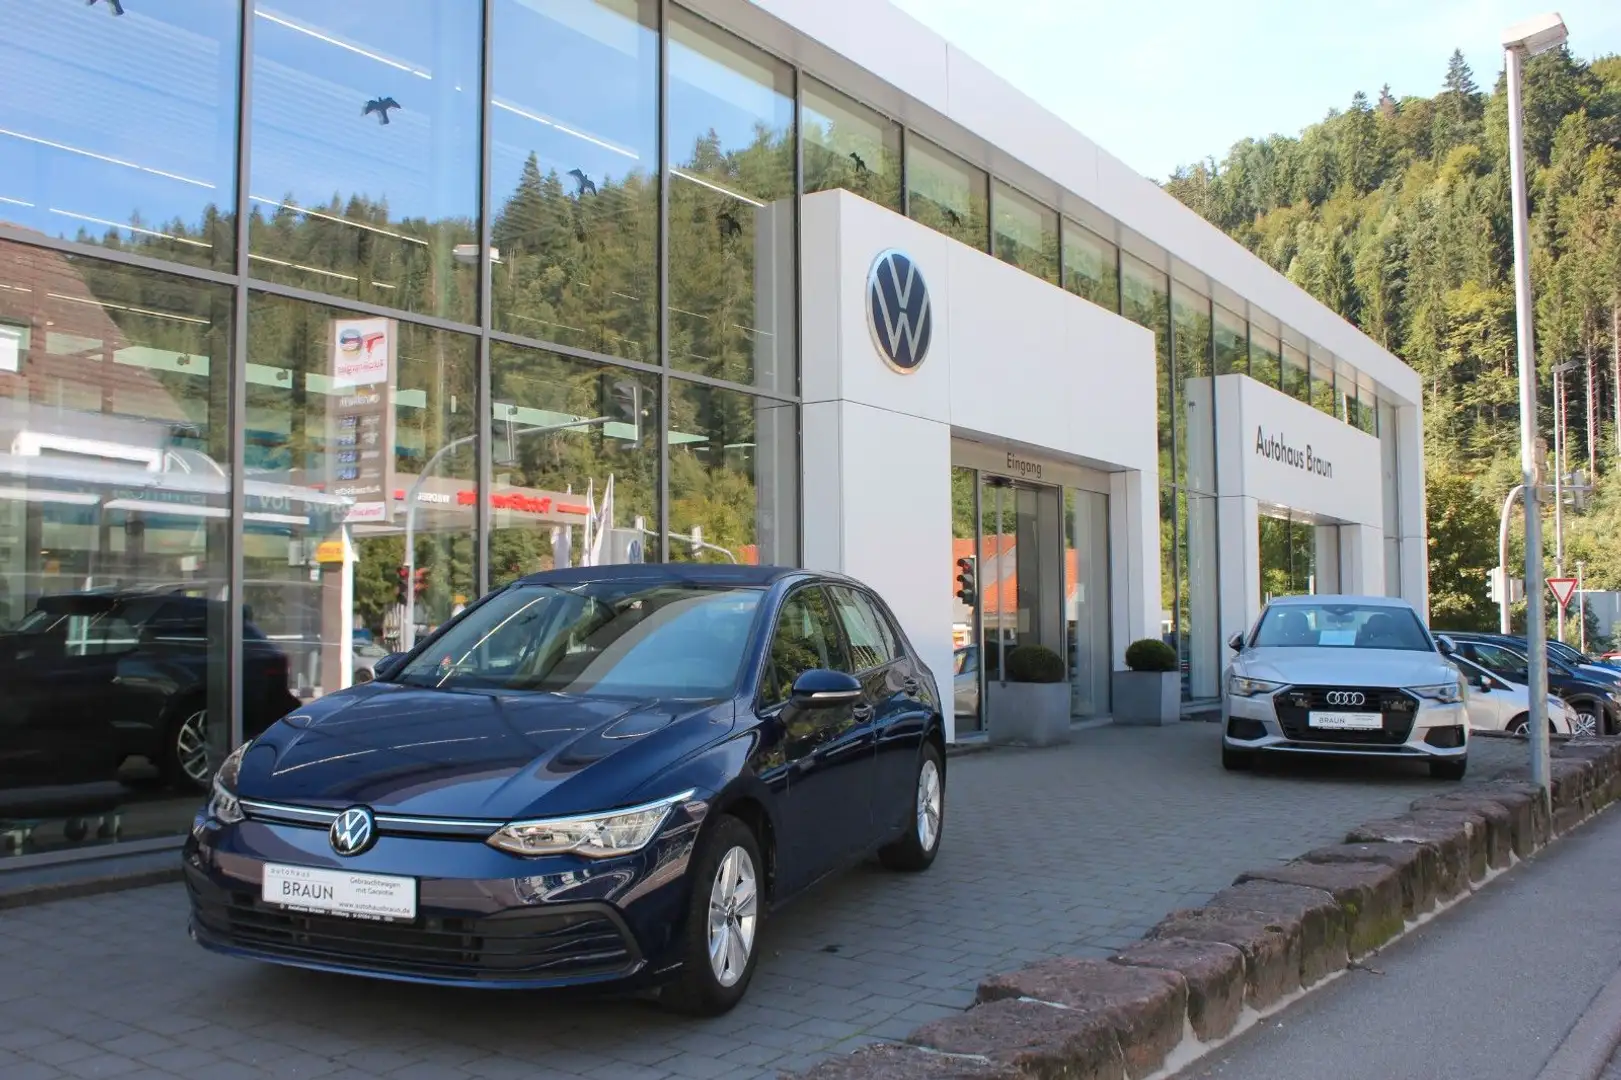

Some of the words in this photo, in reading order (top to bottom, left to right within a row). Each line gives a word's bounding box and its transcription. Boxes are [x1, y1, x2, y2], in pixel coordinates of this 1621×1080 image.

[1256, 425, 1304, 469] Autohaus
[1306, 444, 1333, 478] Braun
[1007, 452, 1042, 479] Eingang
[270, 868, 311, 878] autohaus
[349, 876, 401, 888] Gebrauchtwagen
[282, 880, 333, 900] BRAUN
[368, 887, 394, 897] Garantie
[339, 901, 411, 914] www.autohausbraun.de
